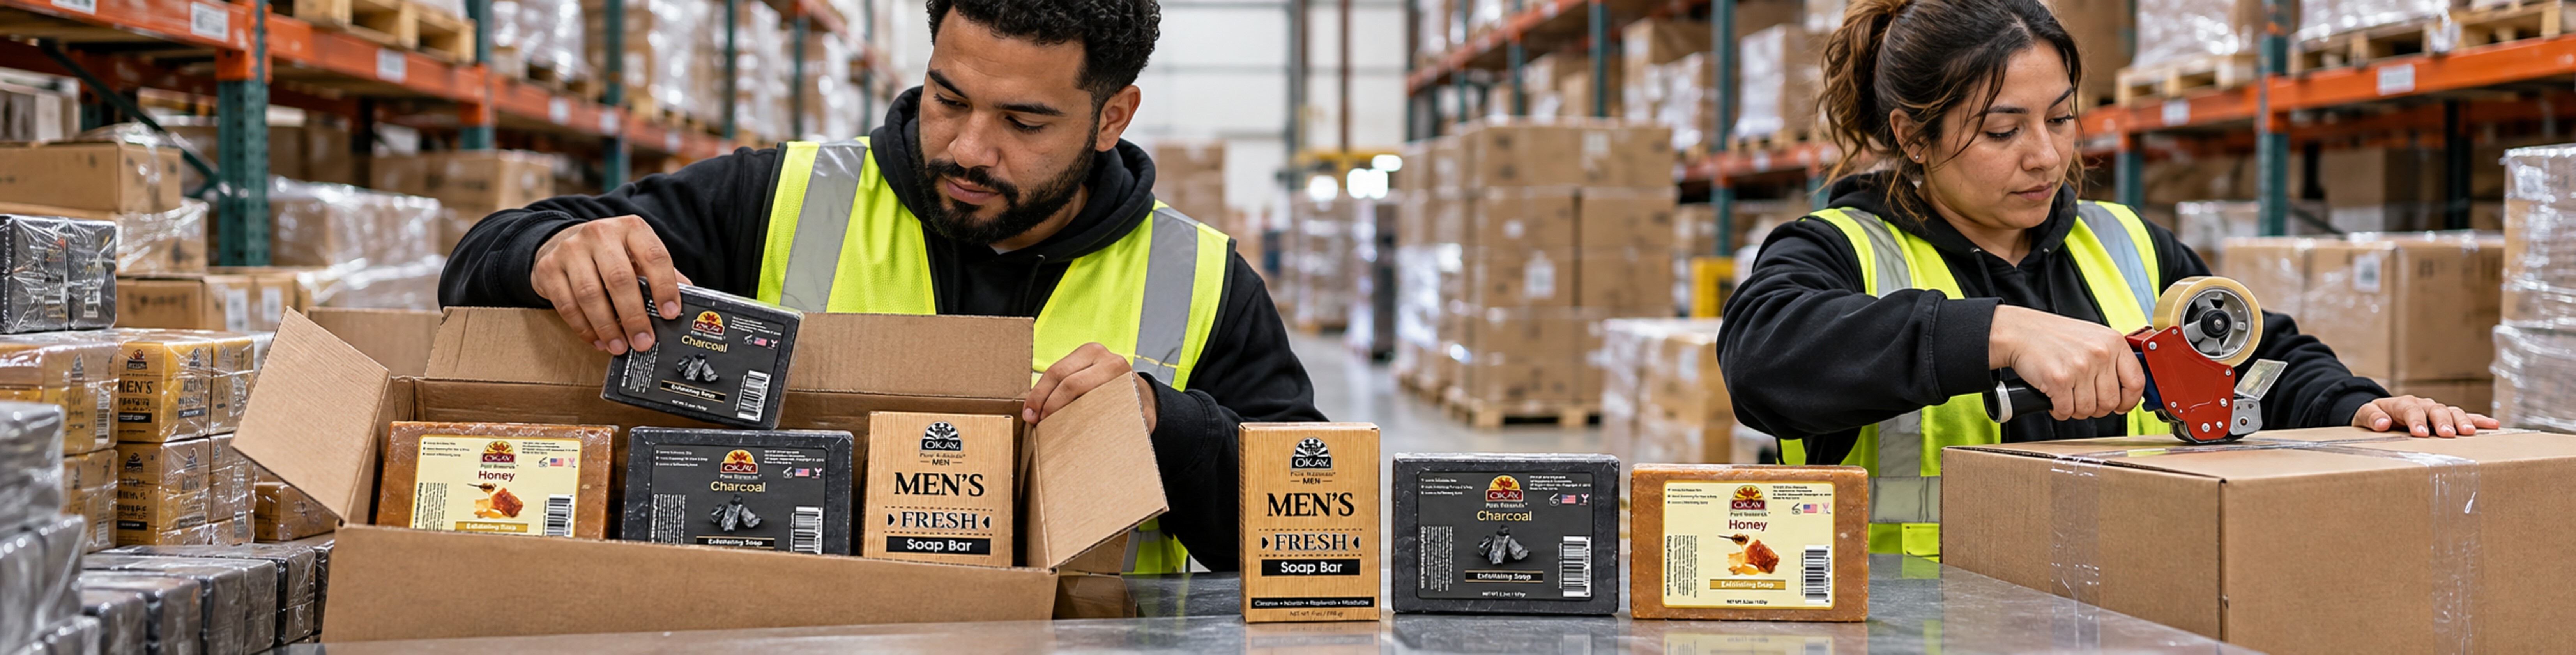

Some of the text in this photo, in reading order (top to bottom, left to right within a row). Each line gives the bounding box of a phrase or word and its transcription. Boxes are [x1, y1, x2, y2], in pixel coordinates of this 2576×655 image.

[681, 335, 728, 352] Charcoal
[478, 471, 515, 482] Honey
[710, 481, 766, 492] Charcoal
[894, 472, 984, 497] MEN'S
[1266, 492, 1354, 517] MEN'S
[901, 511, 978, 529] FRESH
[1476, 510, 1532, 521] Charcoal
[1729, 519, 1768, 531] Honey
[907, 538, 972, 553] Soap Bar
[1275, 533, 1348, 551] FRESH
[1281, 562, 1343, 575] Soap Bar
